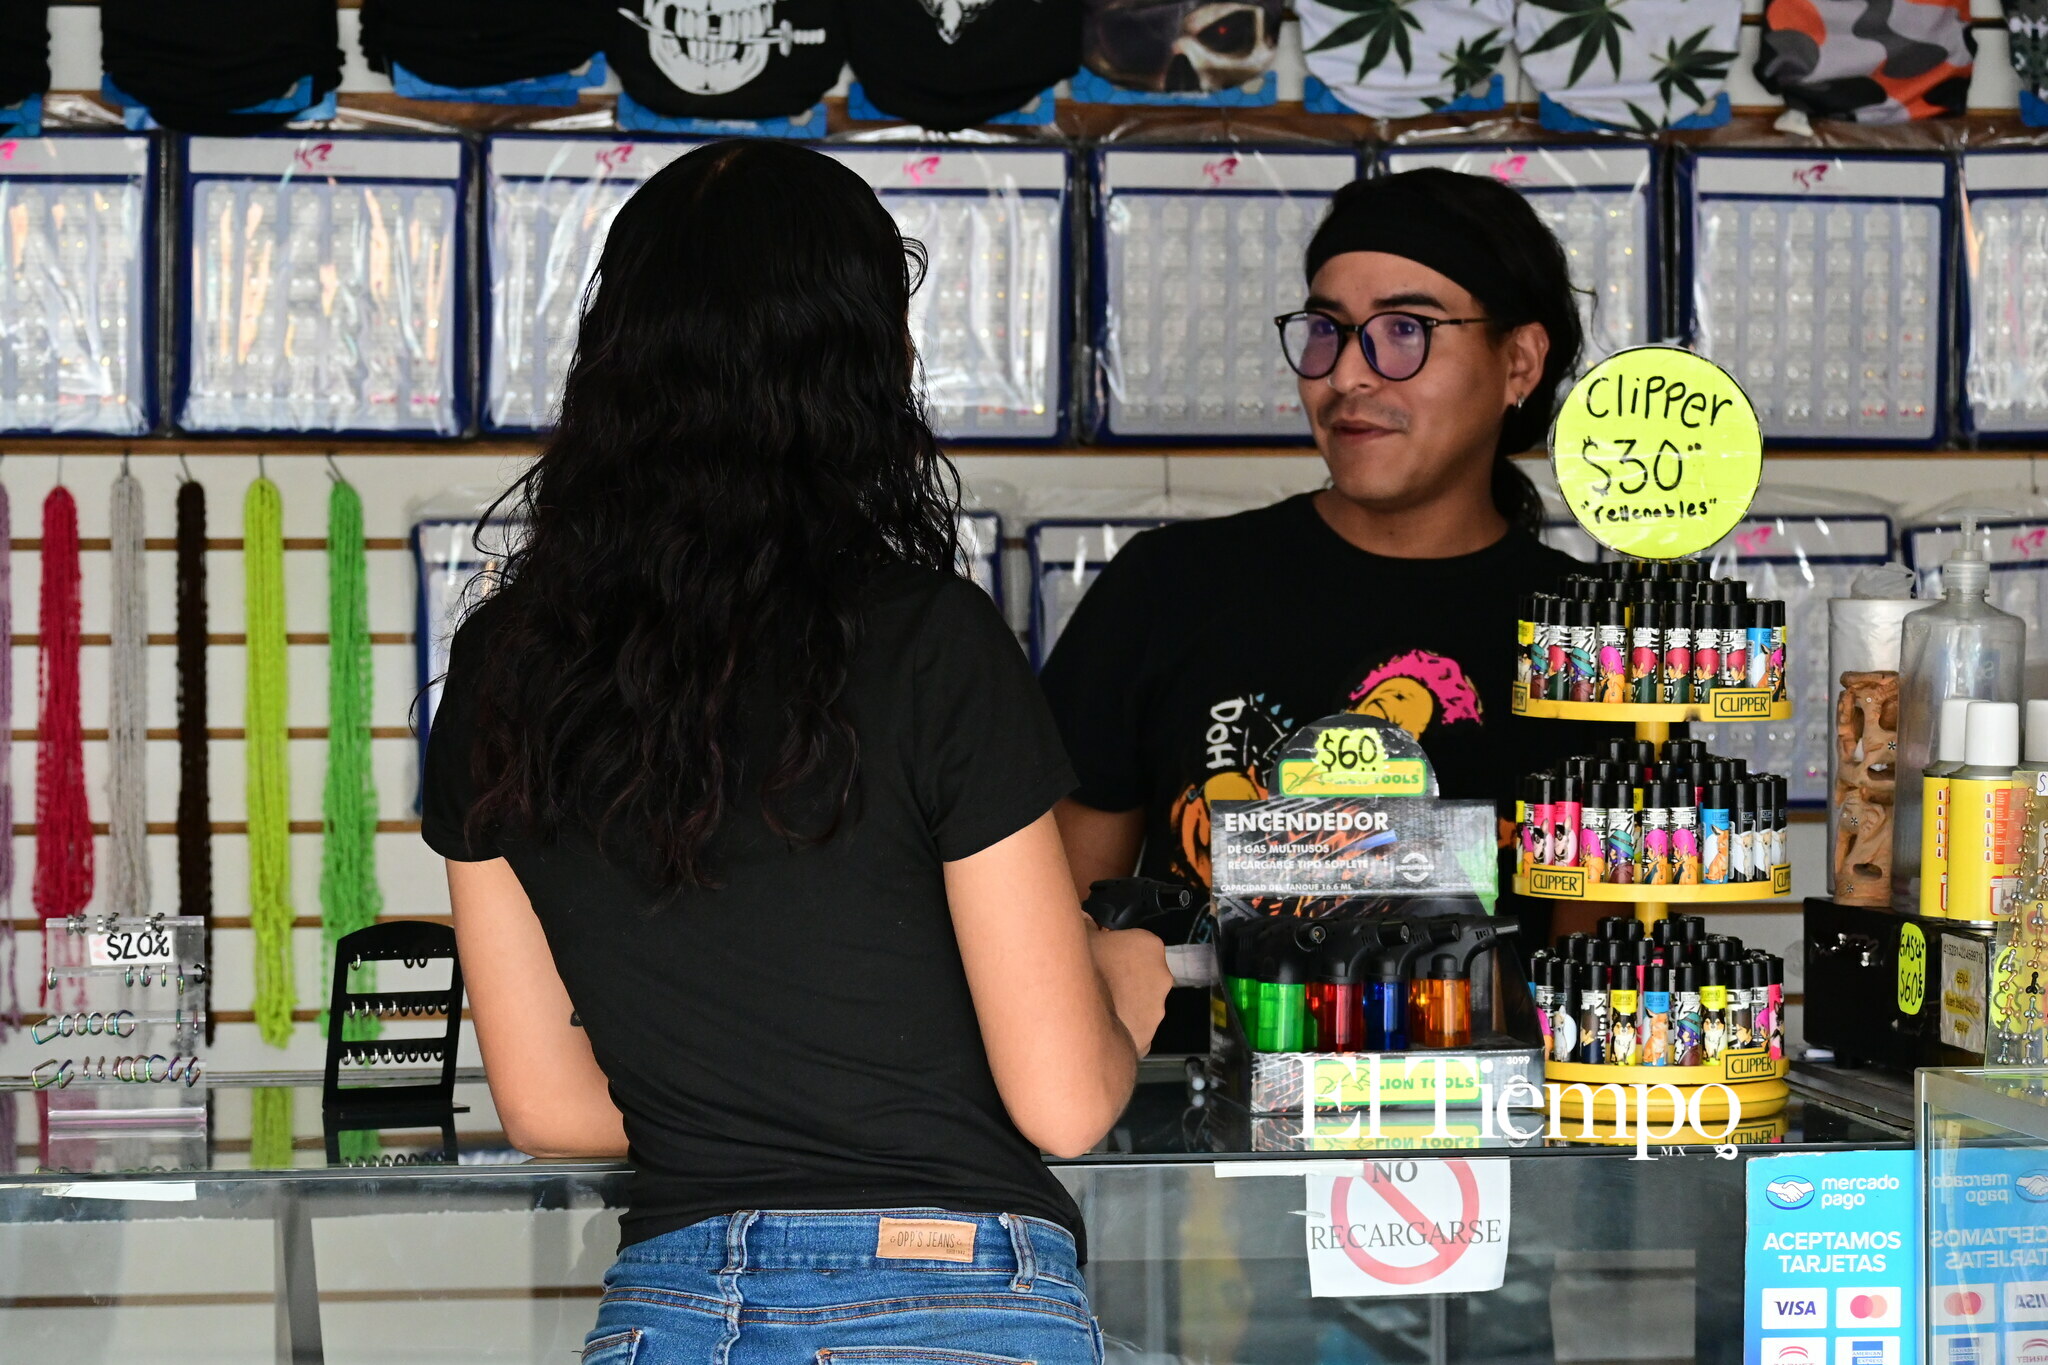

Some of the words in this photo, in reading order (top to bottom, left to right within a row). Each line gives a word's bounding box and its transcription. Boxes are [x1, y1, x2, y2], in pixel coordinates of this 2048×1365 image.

[1720, 697, 1767, 713] CLIPPER
[1224, 812, 1389, 832] ENCENDEDOR
[1227, 845, 1242, 853] DE
[1244, 845, 1266, 853] GAS
[1269, 844, 1330, 853] MULTIUSOS
[1228, 860, 1294, 870] RECARGABLE
[1298, 860, 1321, 869] TIPO
[1325, 860, 1369, 869] SOPLETE
[1220, 884, 1266, 892] CAPACIDAD
[1286, 883, 1319, 891] TANQUE
[1533, 875, 1577, 892] CLIPPER
[1506, 1055, 1531, 1065] 3099
[1371, 1162, 1418, 1184] NO
[1821, 1174, 1900, 1191] mercado
[1821, 1193, 1866, 1210] pago
[926, 1231, 956, 1248] JEANS
[1310, 1219, 1502, 1250] RECARGARSE
[1763, 1231, 1902, 1251] ACEPTAMOS
[1778, 1254, 1887, 1273] TARJETAS
[1774, 1300, 1817, 1316] VISA
